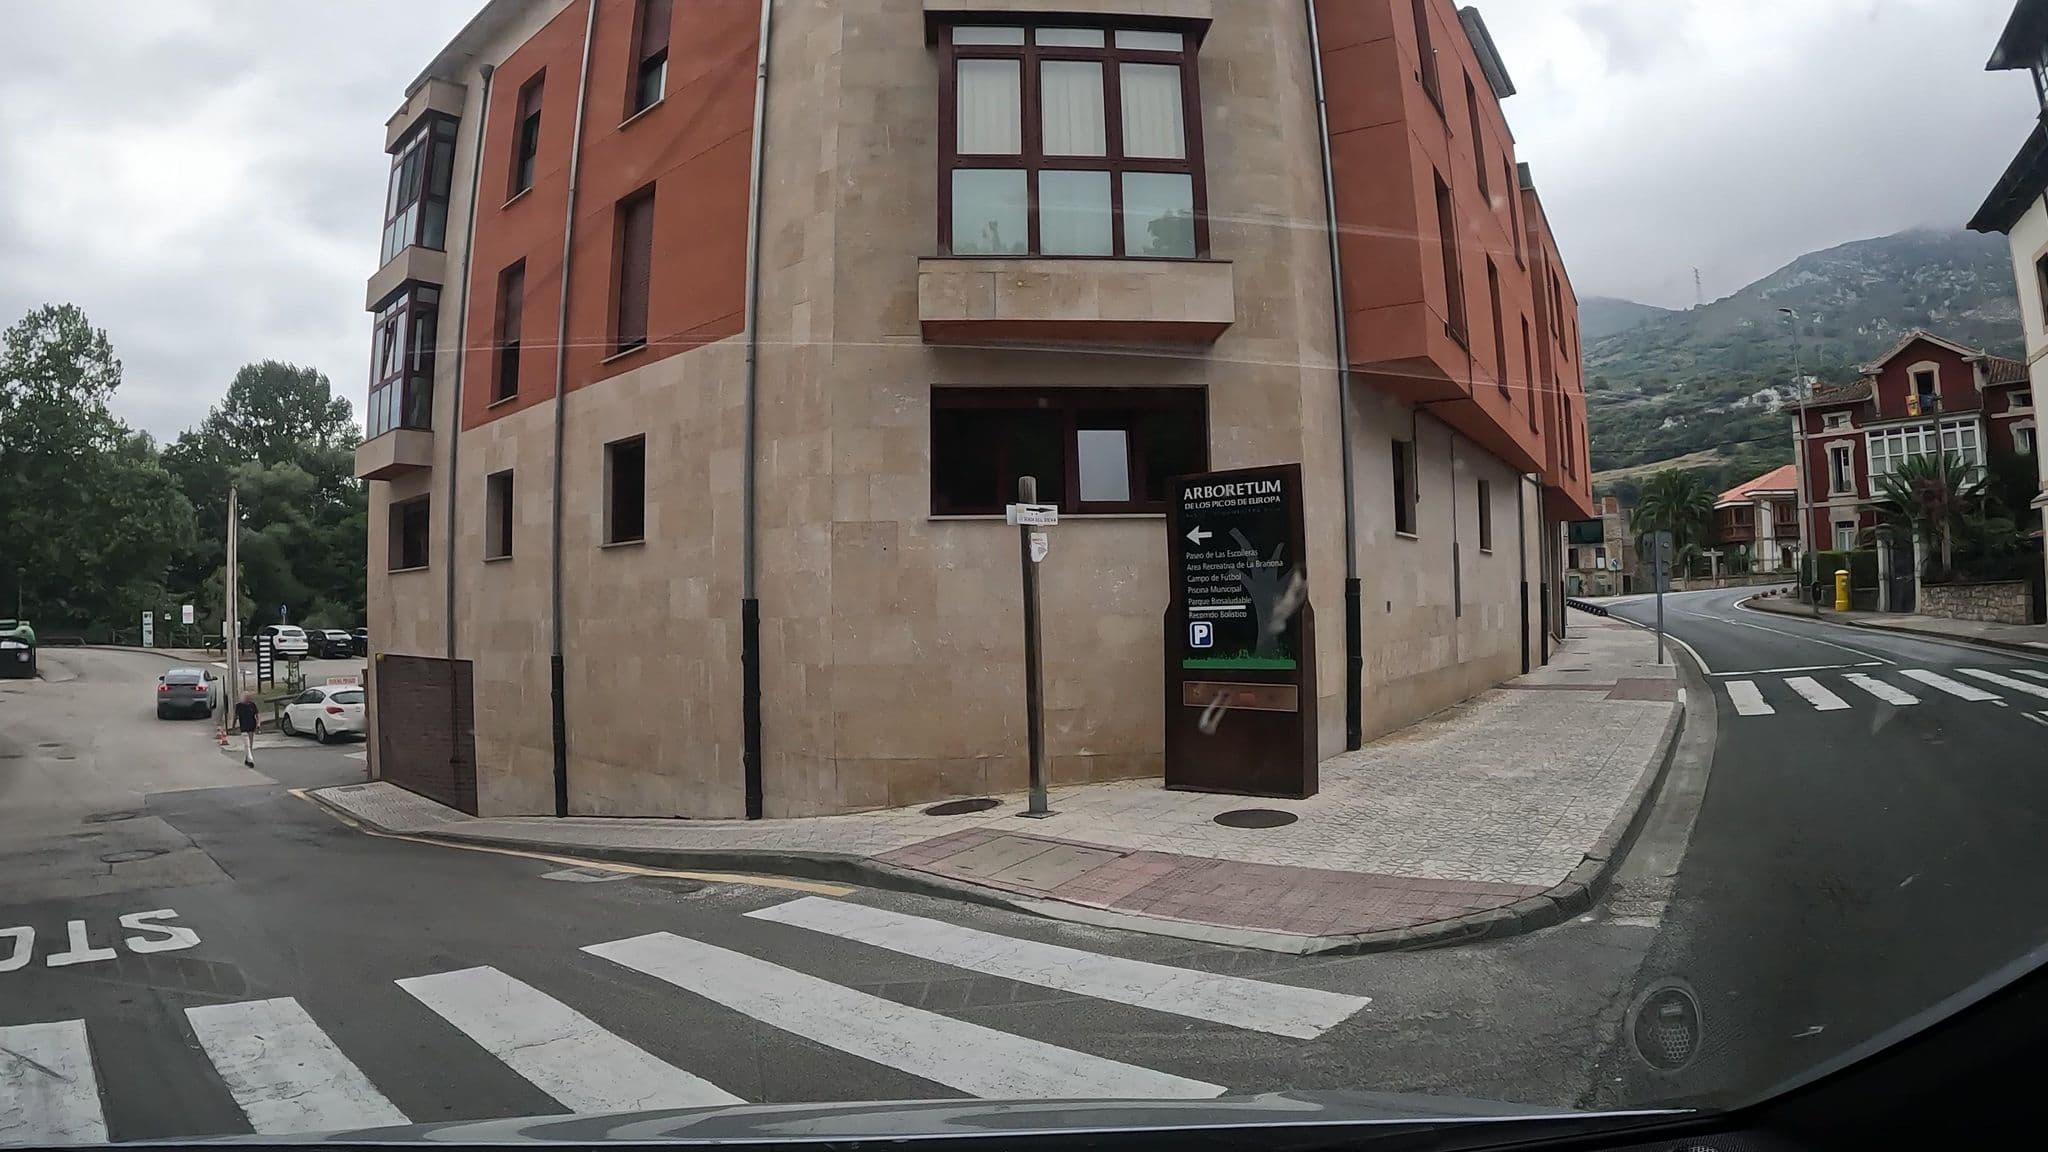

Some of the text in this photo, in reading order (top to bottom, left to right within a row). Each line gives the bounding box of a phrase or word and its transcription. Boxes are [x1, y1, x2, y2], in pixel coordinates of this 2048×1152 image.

[1184, 480, 1281, 500] ARBORETUM
[1195, 501, 1211, 509] LOS
[1212, 499, 1236, 508] PICOS
[1237, 498, 1247, 506] DE
[1248, 496, 1281, 505] EUROPA
[1205, 551, 1214, 559] de
[1203, 562, 1235, 570] Recreativa
[1236, 561, 1245, 569] de
[1246, 560, 1255, 568] La
[1187, 574, 1209, 583] Campo
[1210, 573, 1219, 581] de
[1188, 584, 1242, 594] Piscina Municipal
[1188, 595, 1252, 606] Parque Biosaludable
[1188, 611, 1218, 619] Recorrido
[1194, 625, 1208, 645] P
